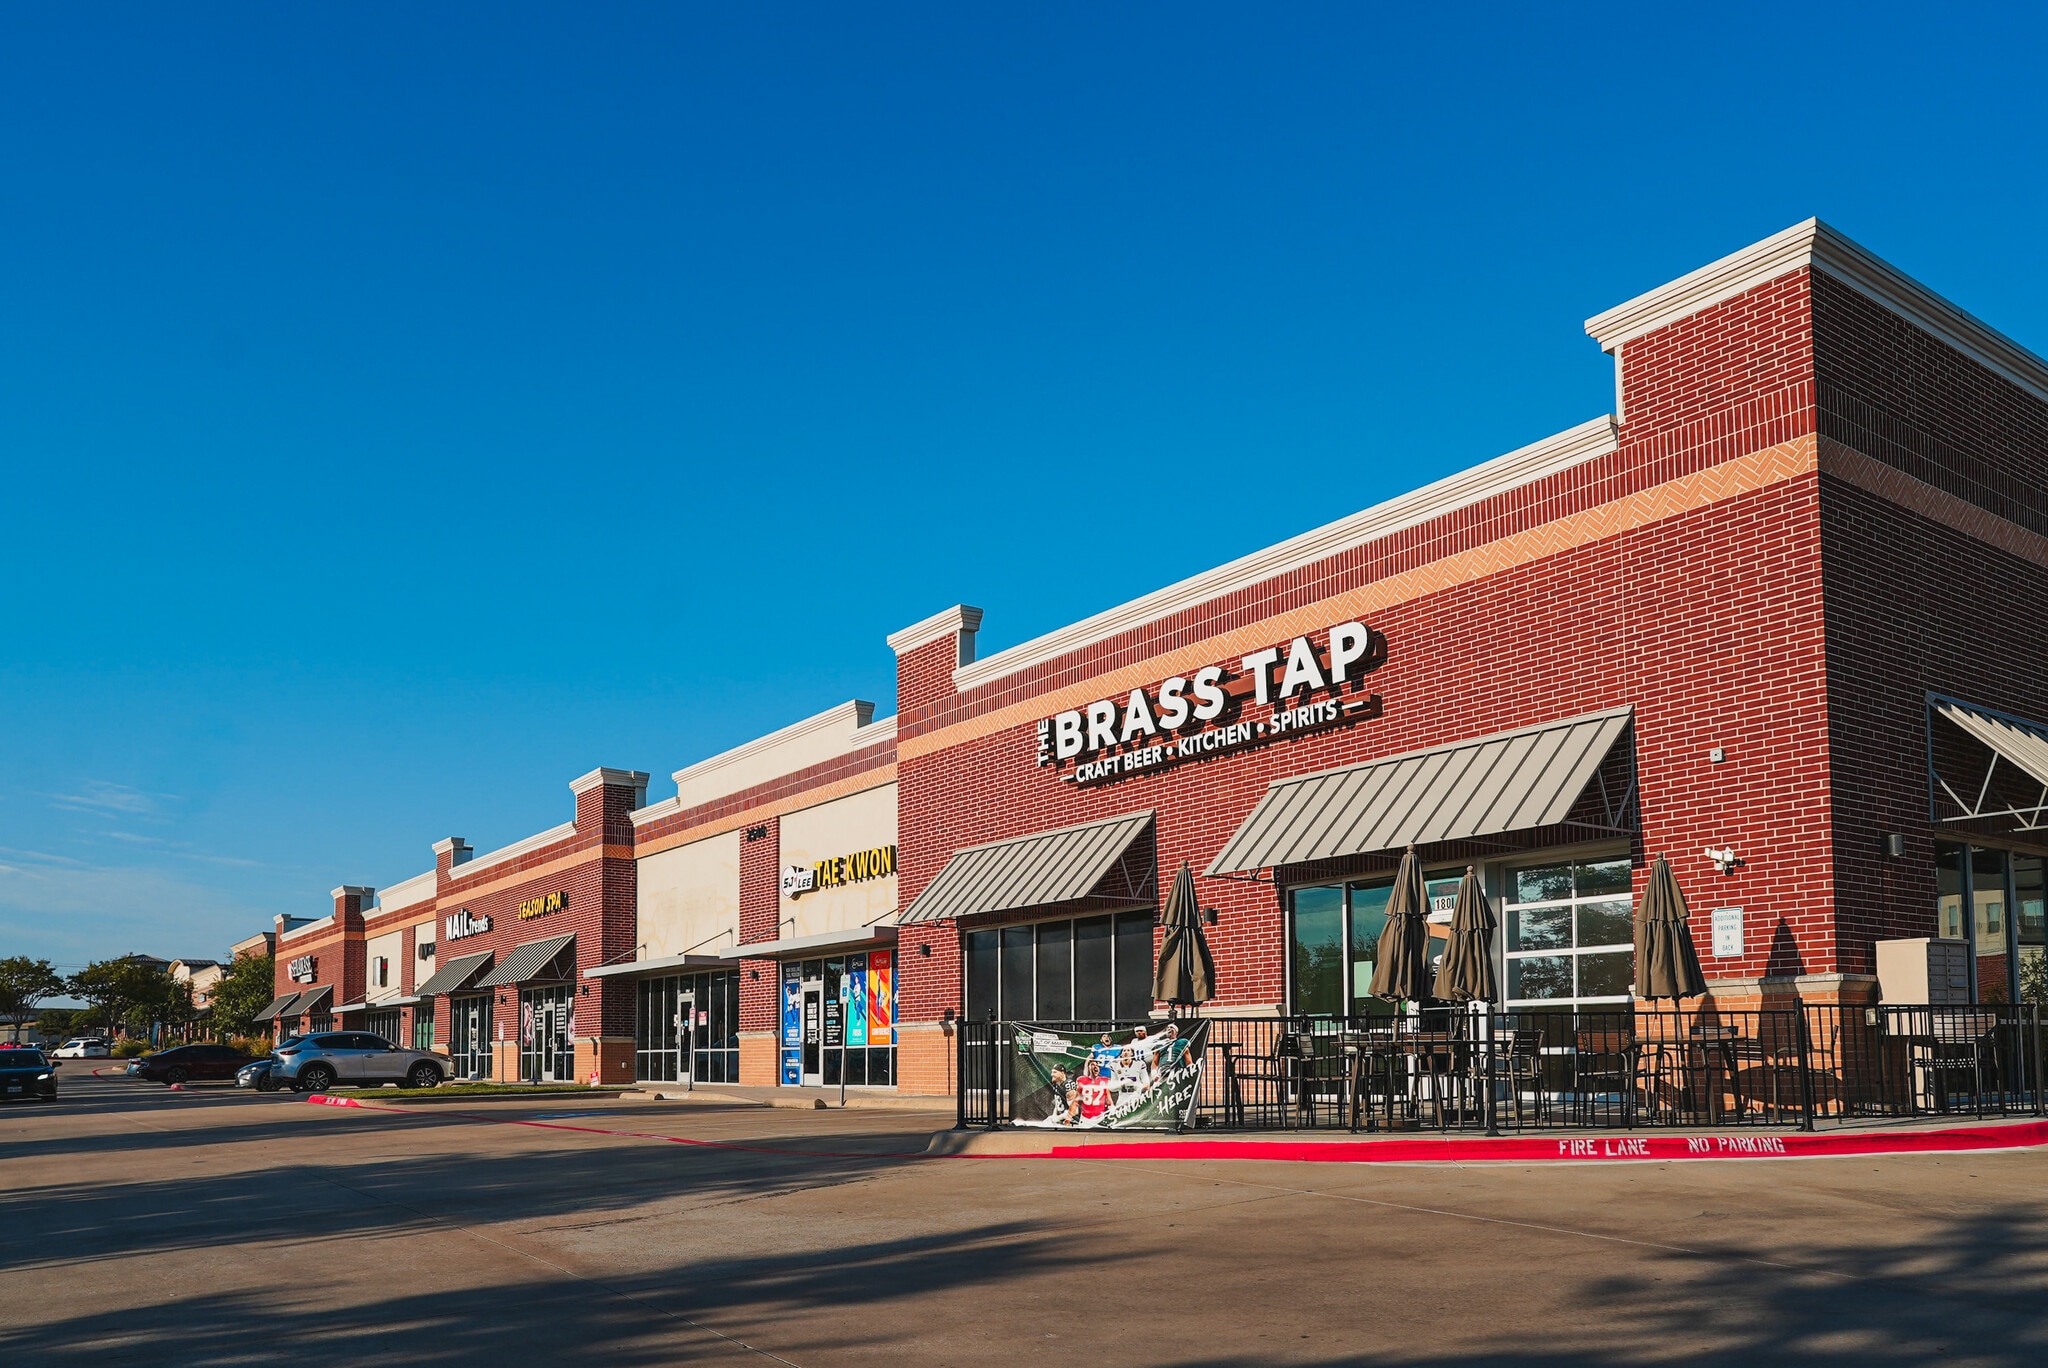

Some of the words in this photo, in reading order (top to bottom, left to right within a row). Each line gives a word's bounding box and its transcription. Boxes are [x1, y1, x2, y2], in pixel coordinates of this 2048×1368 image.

[1056, 666, 1225, 760] BRASS
[1241, 621, 1368, 706] TAP
[1037, 718, 1049, 767] THE
[1076, 756, 1123, 783] CRAFT
[1124, 745, 1162, 771] BEER
[1178, 721, 1251, 758] KITCHEN
[1270, 698, 1338, 734] SPIRITS
[518, 896, 545, 920] SEASON
[546, 891, 561, 912] SPA
[1718, 923, 1737, 931] PARKING
[1081, 1084, 1107, 1106] 87
[1157, 1085, 1193, 1117] HERE
[1558, 1139, 1598, 1156] FIRE
[1605, 1138, 1651, 1157] LANE
[1686, 1137, 1710, 1153] NO
[1718, 1136, 1786, 1154] PARKING
